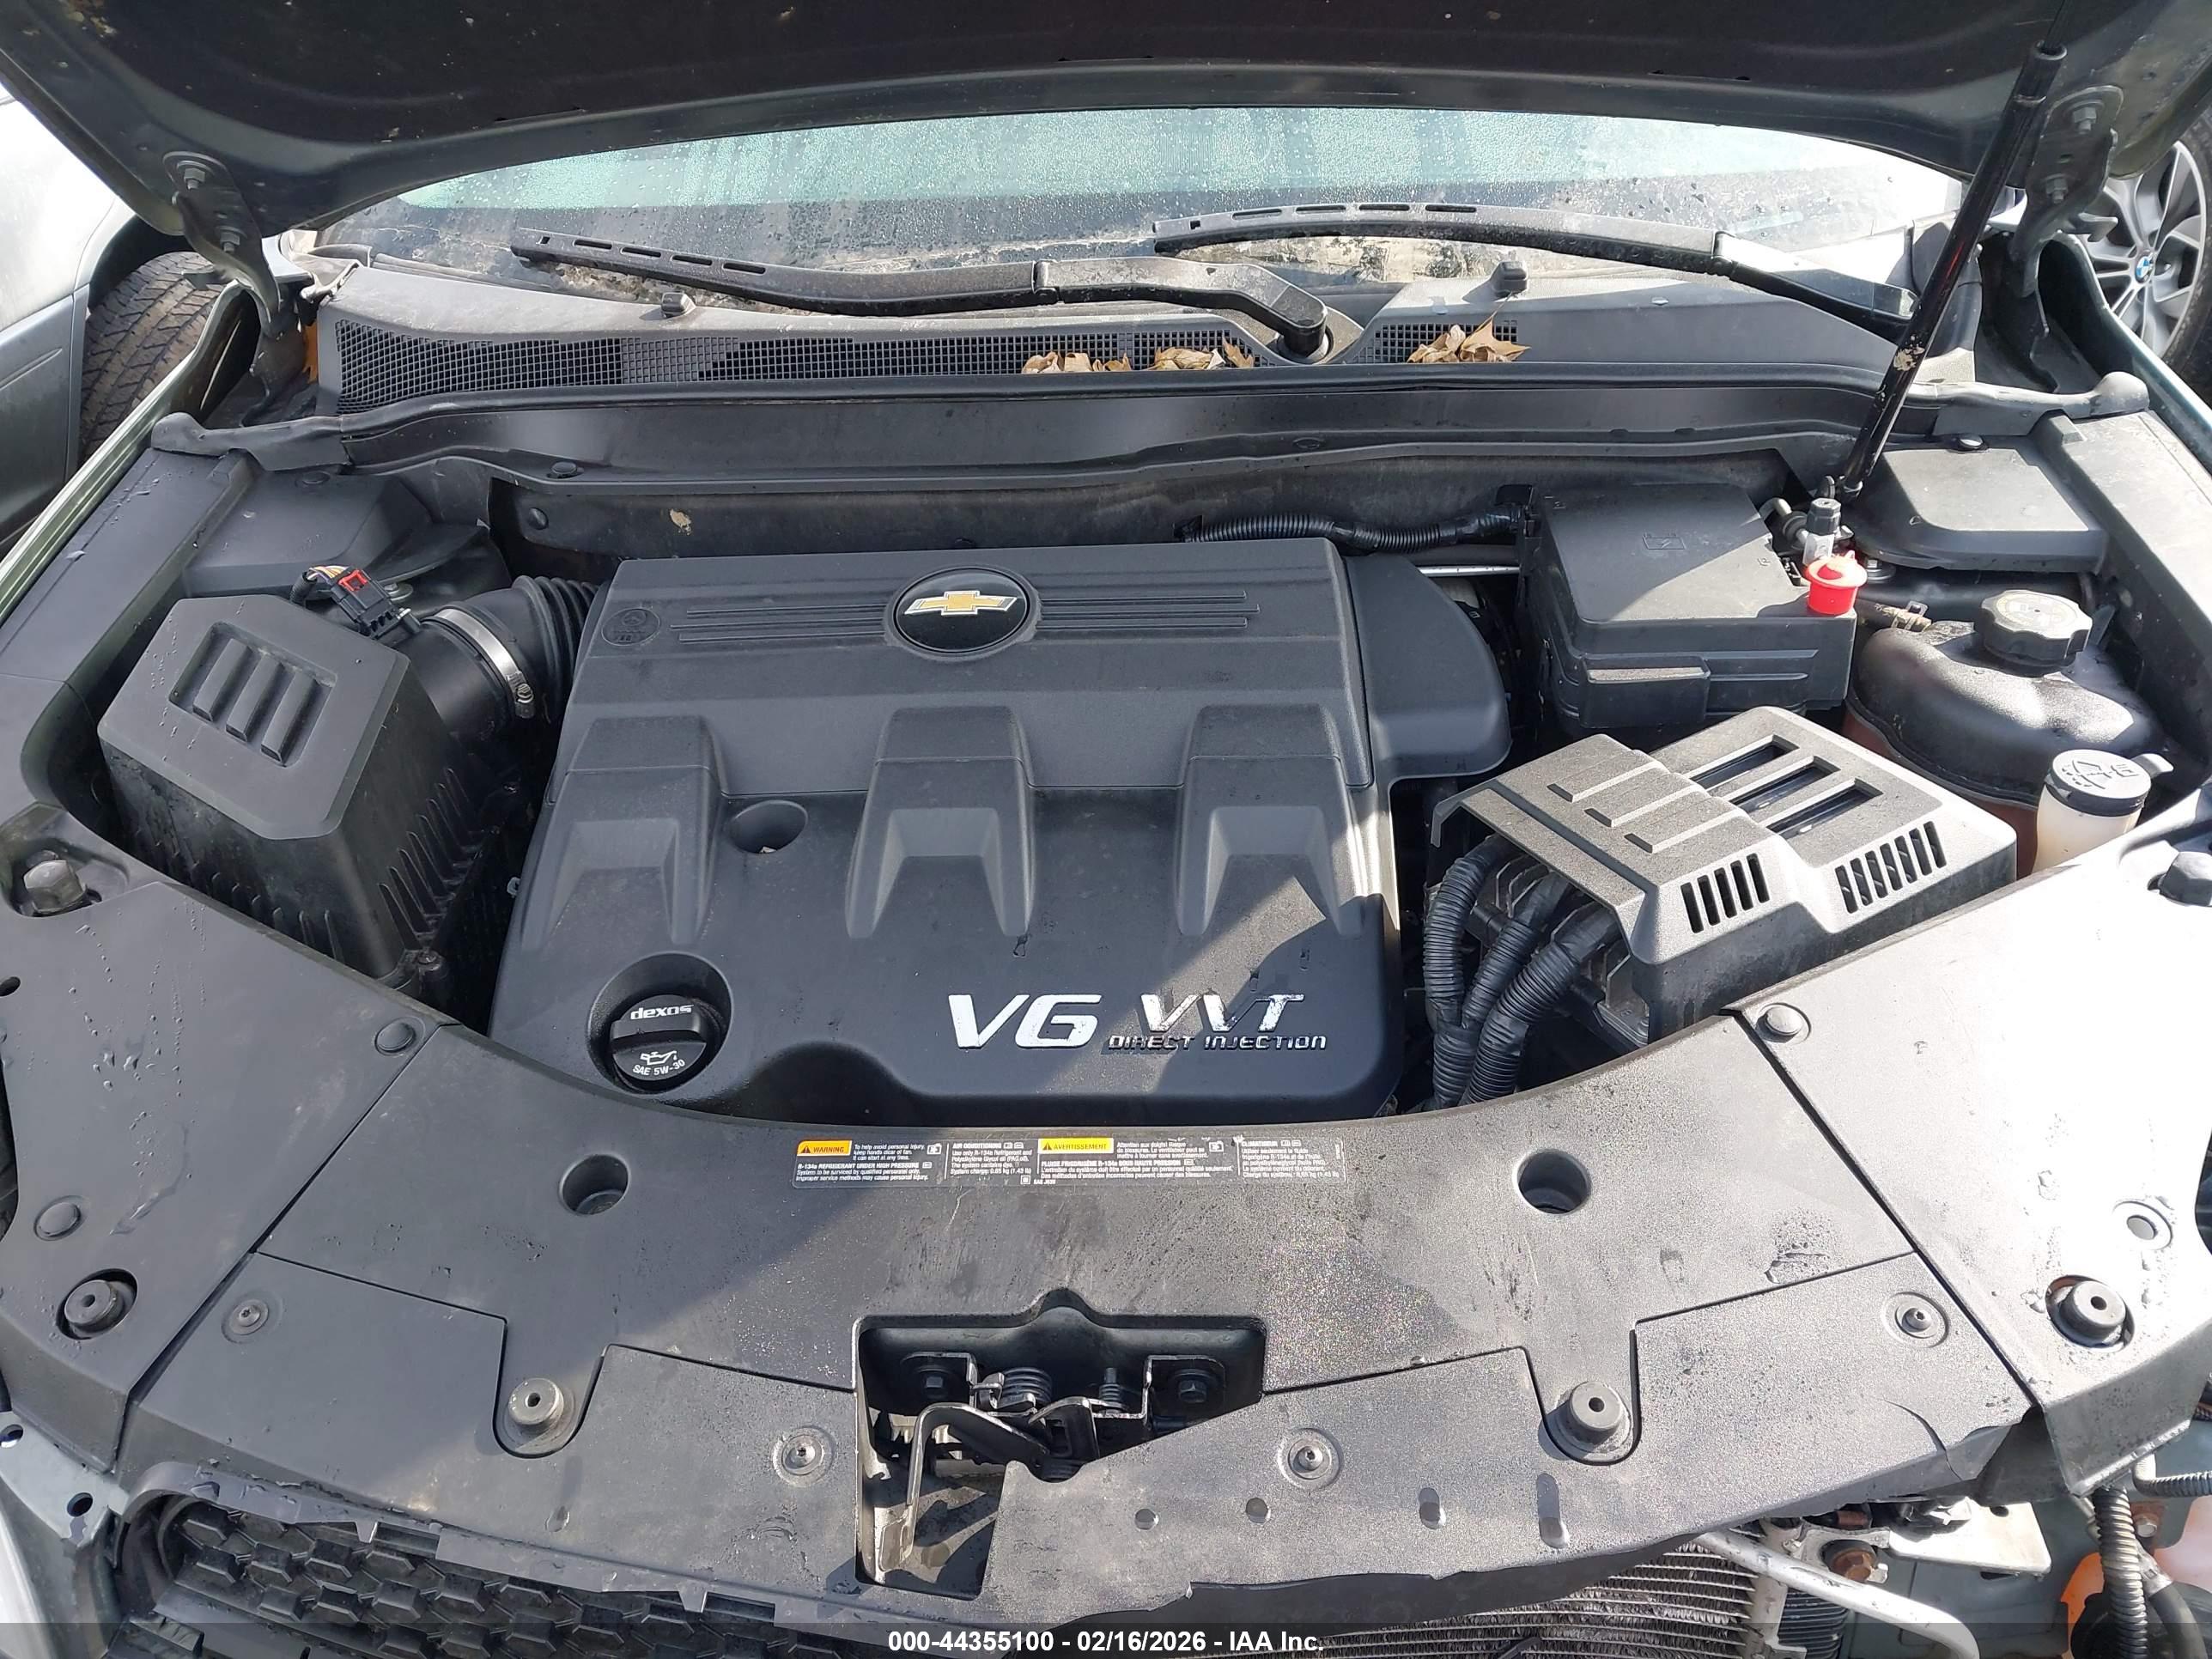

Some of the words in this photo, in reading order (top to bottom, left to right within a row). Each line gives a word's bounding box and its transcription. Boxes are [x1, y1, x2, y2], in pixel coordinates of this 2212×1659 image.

[630, 1005, 694, 1019] dexos
[948, 994, 1102, 1048] V6
[1141, 994, 1304, 1031] VVT
[1108, 1035, 1194, 1051] DIRECT
[1205, 1035, 1327, 1050] INJECTION
[633, 1065, 651, 1075] SAE
[654, 1060, 685, 1075] 5W-30
